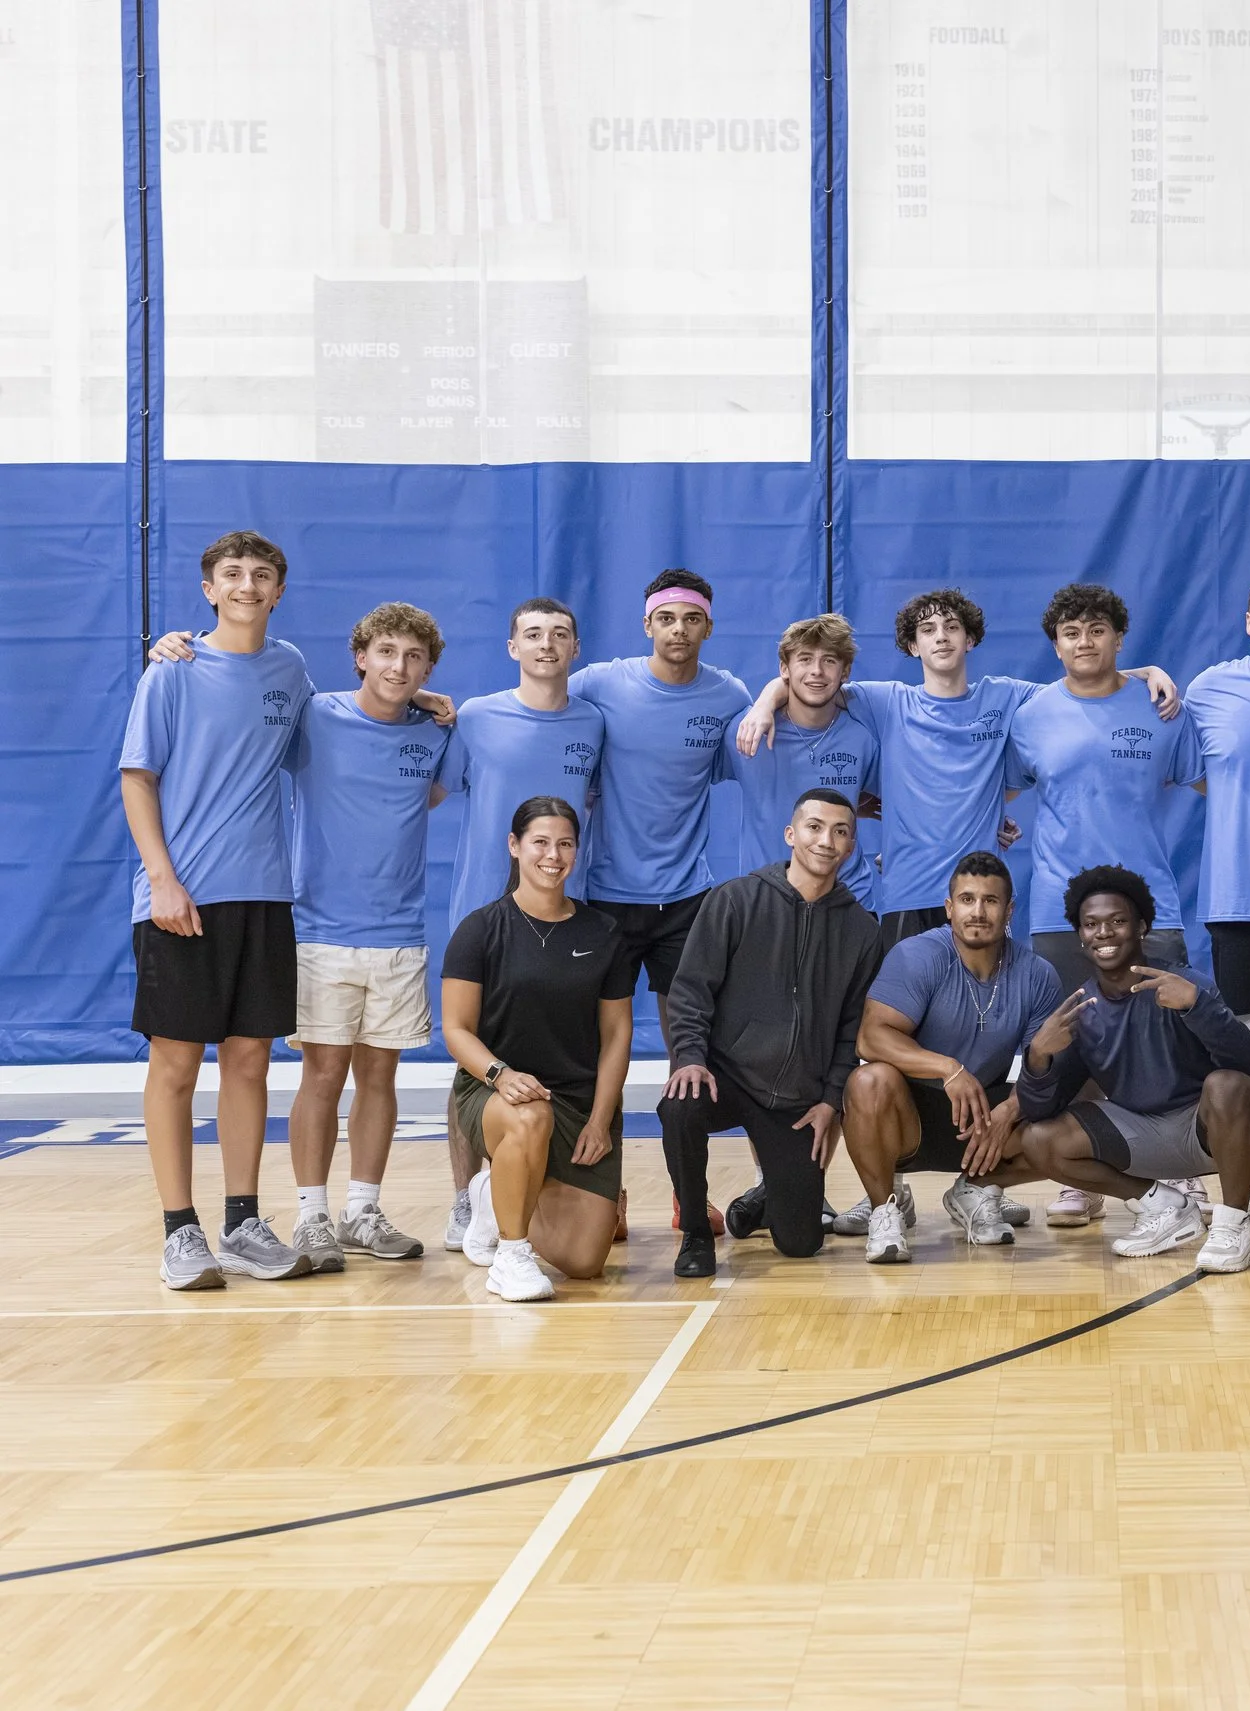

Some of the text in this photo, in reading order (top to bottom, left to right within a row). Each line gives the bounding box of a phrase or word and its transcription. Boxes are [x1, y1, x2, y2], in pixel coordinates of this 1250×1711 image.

[929, 27, 1008, 45] FOOTBALL
[166, 117, 800, 155] STATE CHAMPIONS
[321, 342, 400, 359] TANNERS
[424, 346, 476, 358] PERIOD
[509, 342, 573, 359] GUEST
[400, 416, 454, 429] PLAYER
[536, 416, 582, 429] FOULS
[1111, 727, 1153, 741] PEABODY
[399, 743, 433, 759] PEABODY
[1110, 749, 1152, 760] TANNERS
[819, 752, 858, 767] PEABODY
[819, 776, 858, 785] TANNERS
